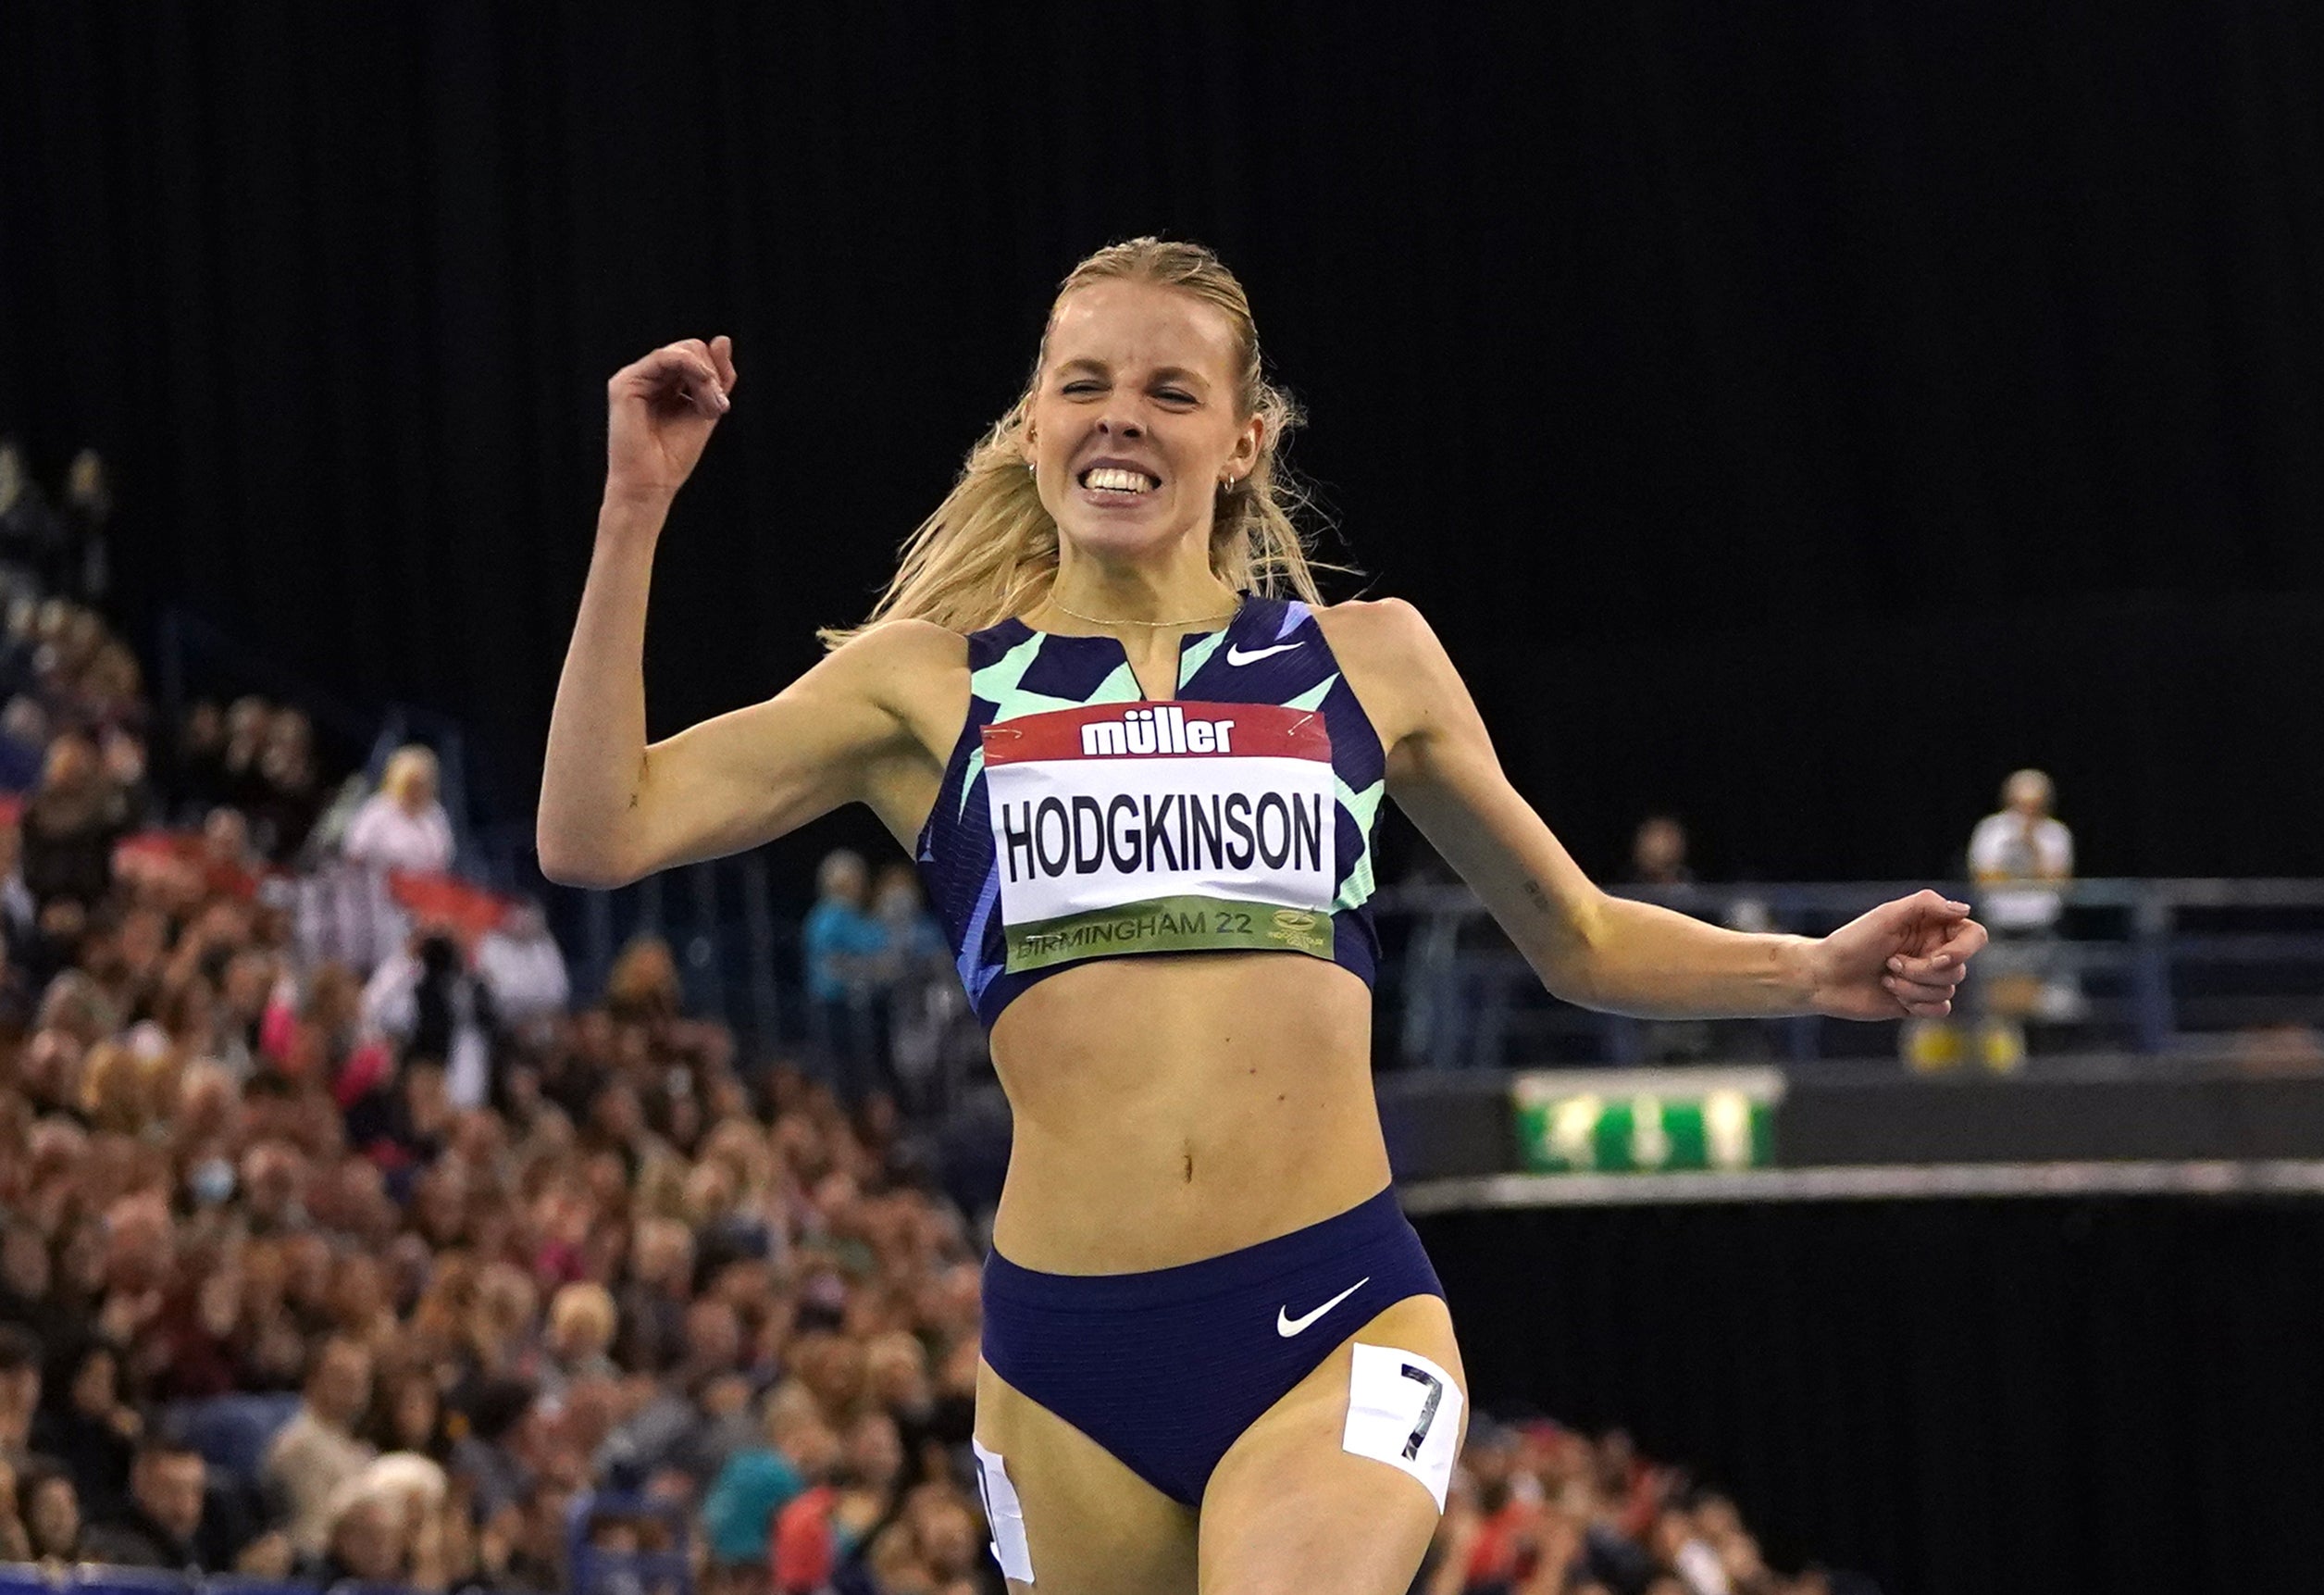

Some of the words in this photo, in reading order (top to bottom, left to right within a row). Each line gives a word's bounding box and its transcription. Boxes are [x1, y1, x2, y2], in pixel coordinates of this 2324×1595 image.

[1081, 706, 1235, 755] müller
[1002, 791, 1321, 882] HODGKINSON
[1016, 913, 1206, 959] BIRMINGHAM
[1216, 912, 1253, 934] 22
[1401, 1364, 1443, 1462] 7
